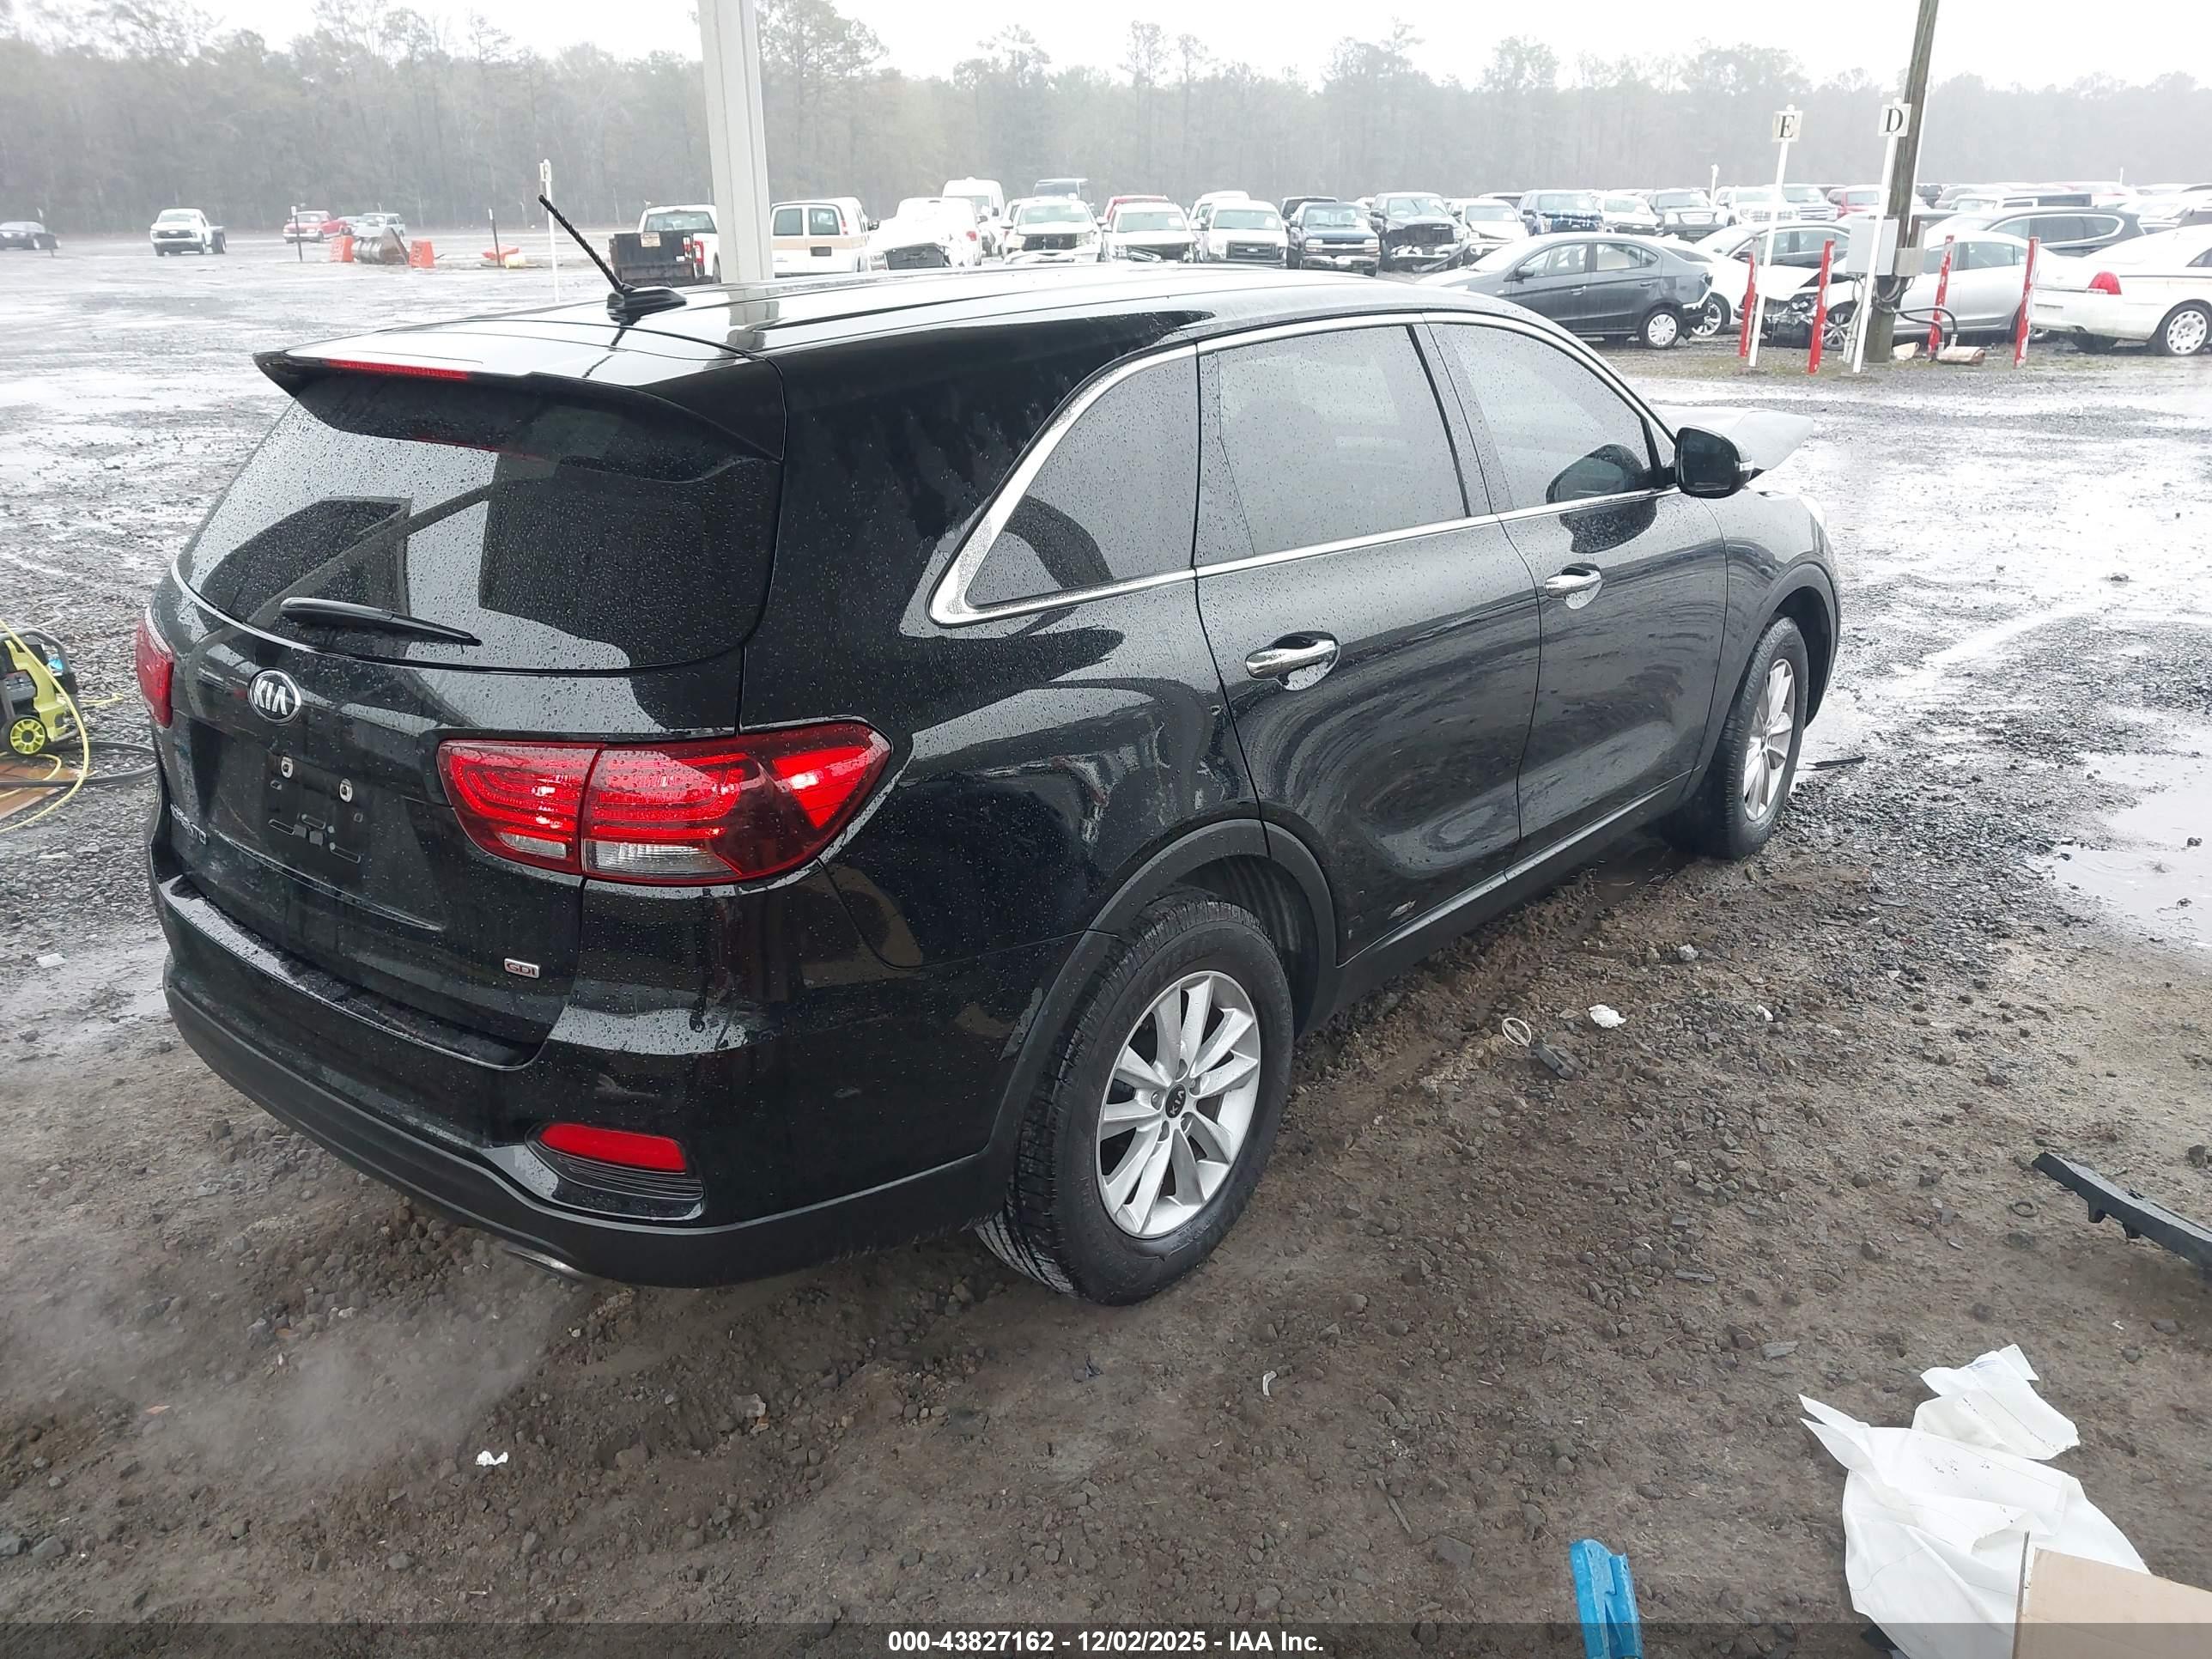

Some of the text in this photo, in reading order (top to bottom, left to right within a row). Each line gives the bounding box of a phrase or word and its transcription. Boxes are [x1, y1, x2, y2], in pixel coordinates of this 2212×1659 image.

[1778, 114, 1796, 138] E
[1884, 107, 1904, 133] D
[253, 677, 289, 716] KIA
[506, 962, 537, 976] GDI
[1169, 1090, 1185, 1115] KIA
